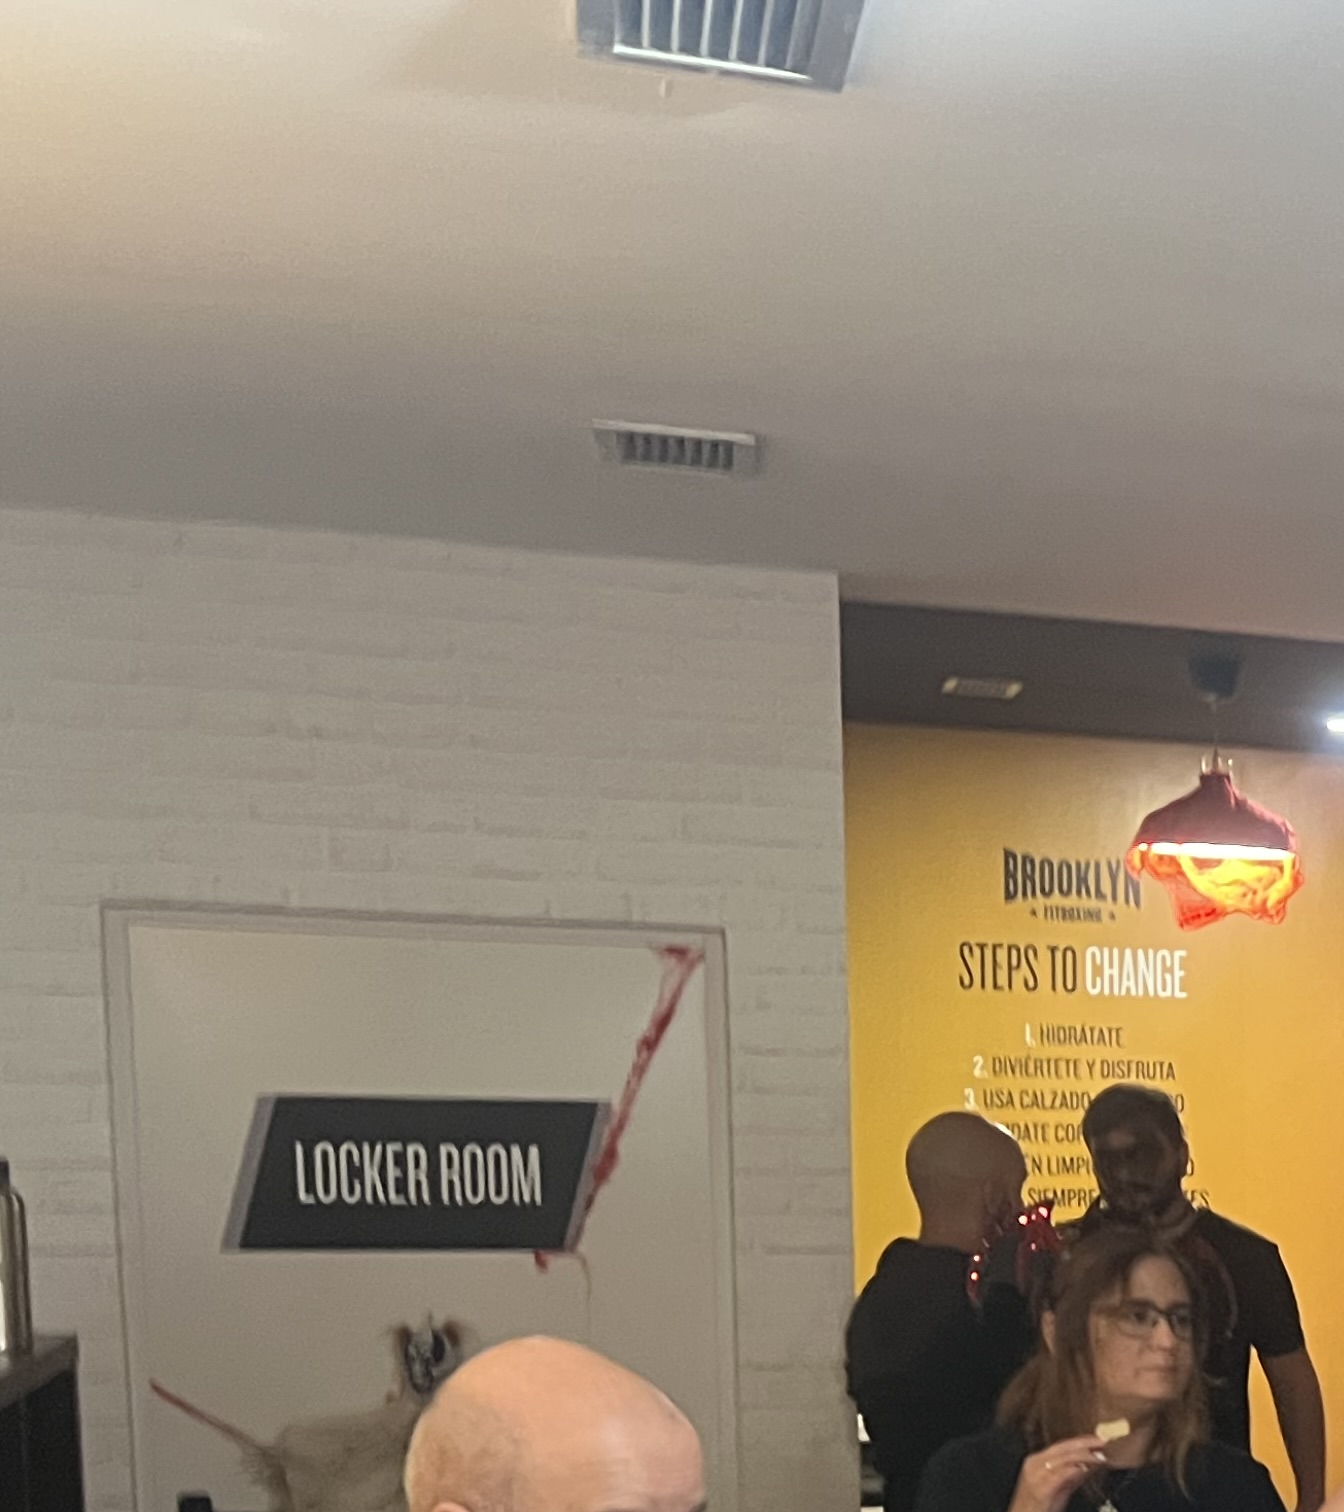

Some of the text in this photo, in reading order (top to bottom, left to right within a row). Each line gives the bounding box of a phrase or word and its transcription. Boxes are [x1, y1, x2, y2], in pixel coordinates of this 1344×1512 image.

[1003, 848, 1141, 911] BROOKLYN
[959, 941, 1188, 998] STEPS TO CHANGE
[1040, 1023, 1125, 1049] HIDRÁTATE
[991, 1053, 1081, 1080] DIVIÉRTETE
[1086, 1060, 1097, 1080] Y
[1100, 1059, 1177, 1082] DISFRUTA
[983, 1088, 1015, 1110] USA
[1019, 1089, 1091, 1112] CALZADO
[295, 1140, 543, 1208] LOCKER ROOM
